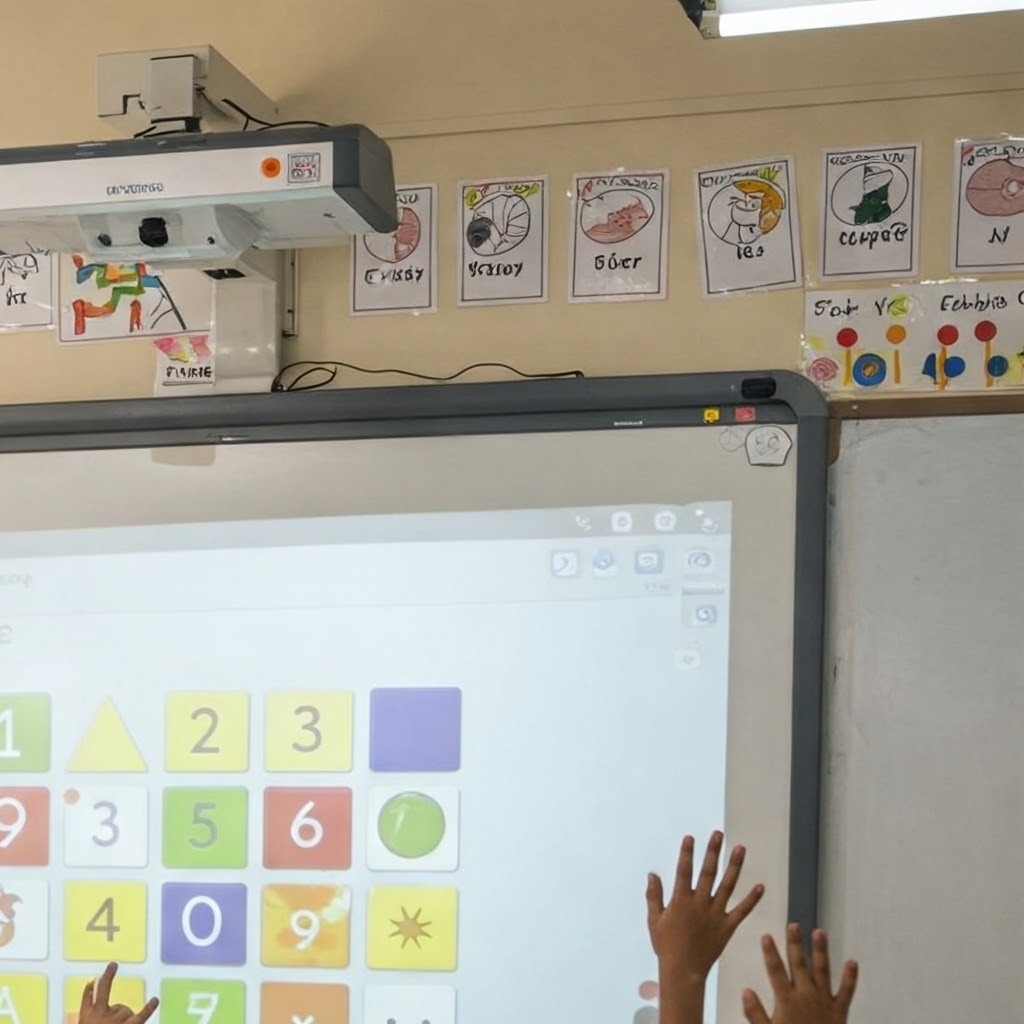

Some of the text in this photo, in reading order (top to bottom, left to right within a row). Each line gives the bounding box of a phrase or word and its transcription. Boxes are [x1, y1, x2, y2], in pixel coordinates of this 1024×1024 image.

[190, 707, 220, 754] 2
[291, 705, 323, 753] 3
[92, 801, 120, 848] 3
[188, 801, 219, 849] 5
[290, 801, 323, 849] 6
[85, 897, 121, 943] 4
[290, 909, 320, 951] 9
